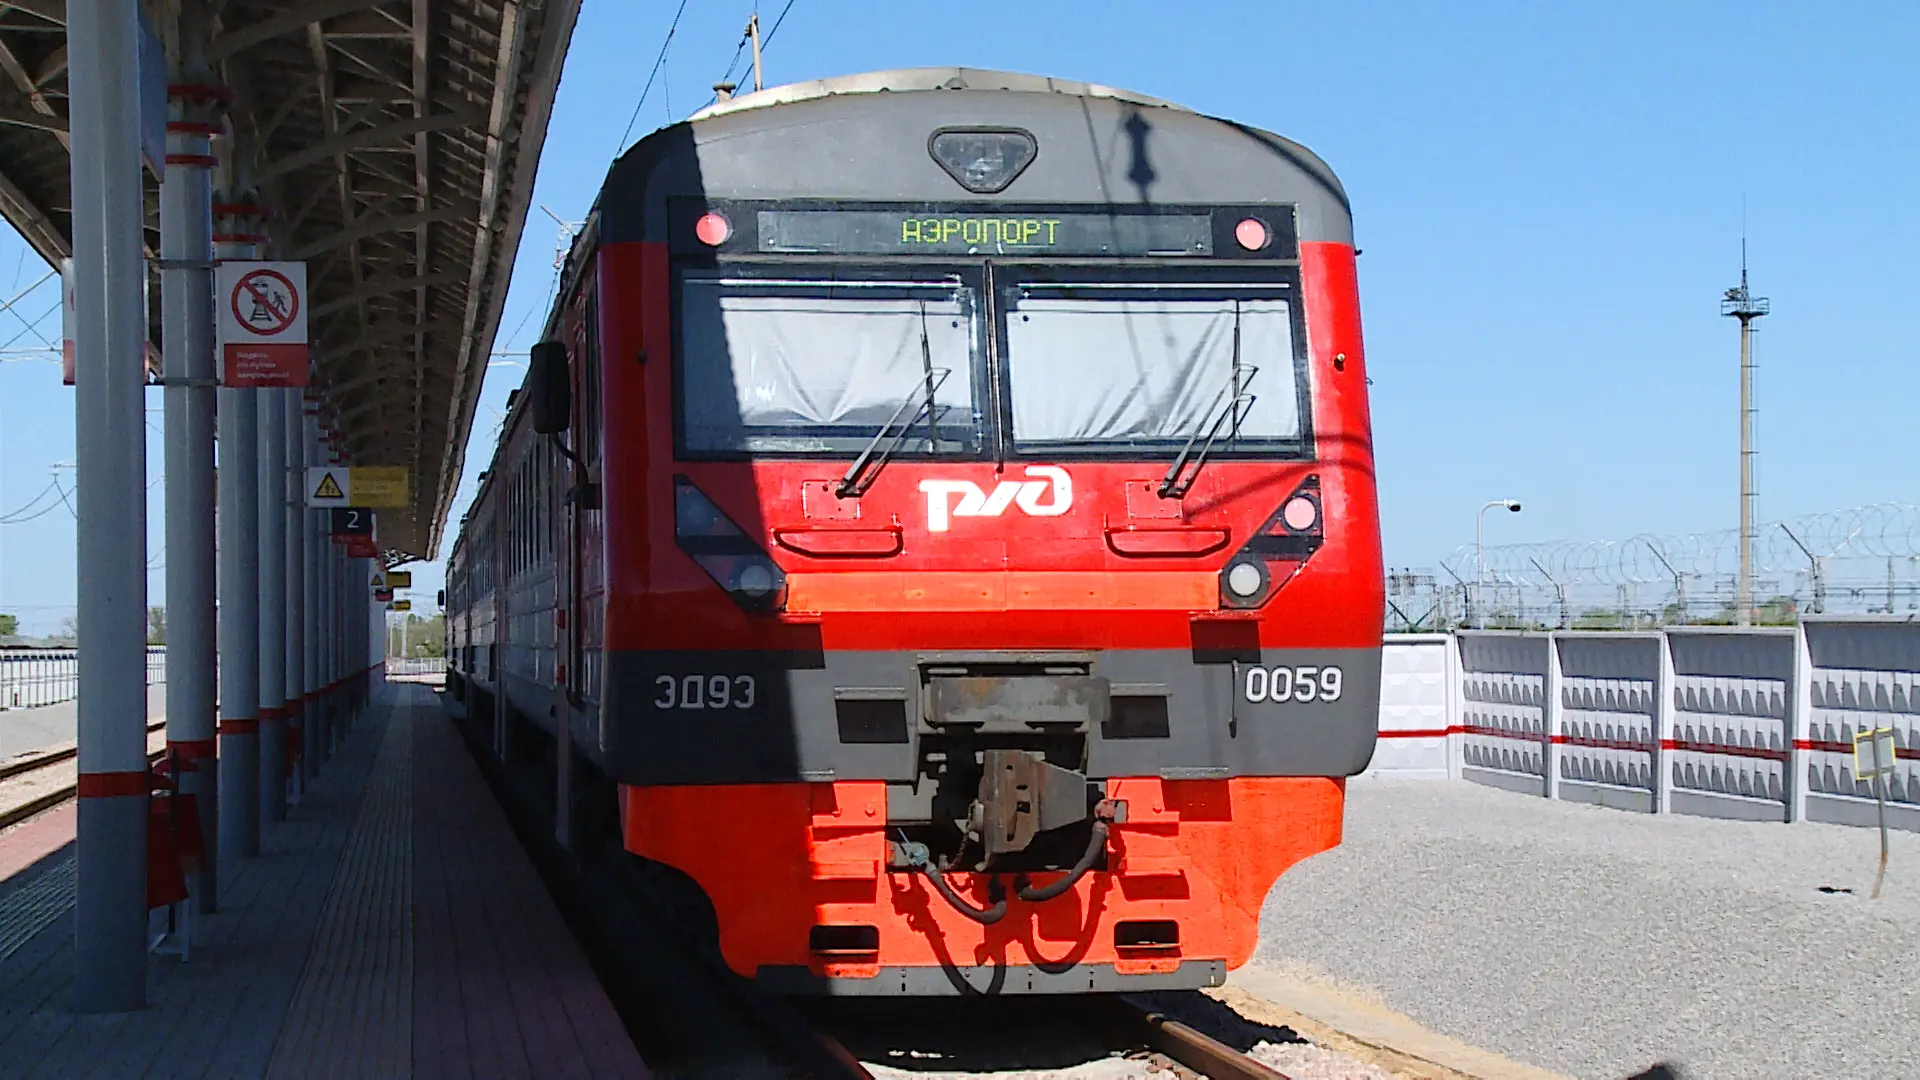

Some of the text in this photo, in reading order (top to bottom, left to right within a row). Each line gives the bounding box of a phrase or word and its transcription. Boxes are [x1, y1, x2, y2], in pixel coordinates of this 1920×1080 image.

[902, 219, 1061, 244] АЭРОПОРТ
[347, 510, 360, 529] 2
[1245, 666, 1343, 703] 0059
